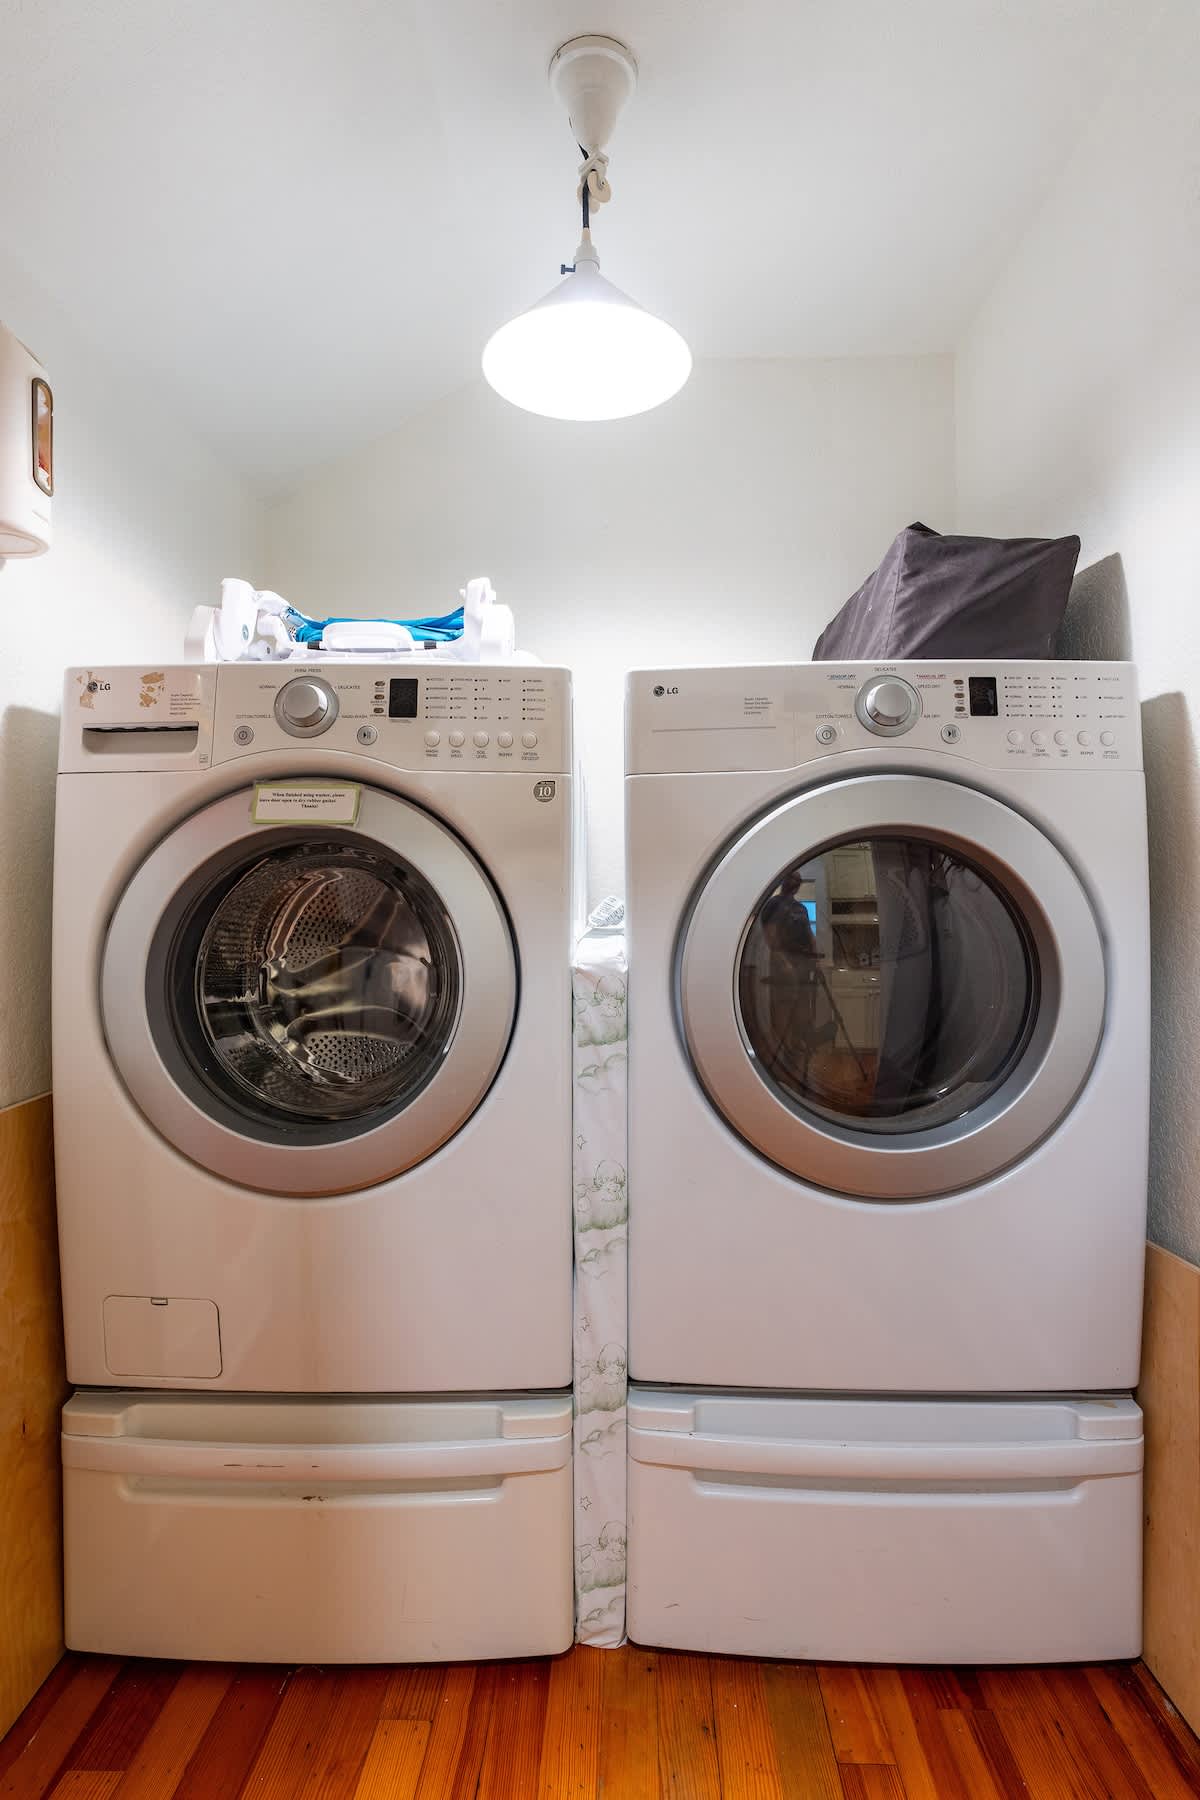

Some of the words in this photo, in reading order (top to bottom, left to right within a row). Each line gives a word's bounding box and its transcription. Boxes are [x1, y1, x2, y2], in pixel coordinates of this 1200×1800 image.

[99, 683, 111, 691] LG
[666, 687, 679, 695] LG
[538, 786, 551, 797] 10
